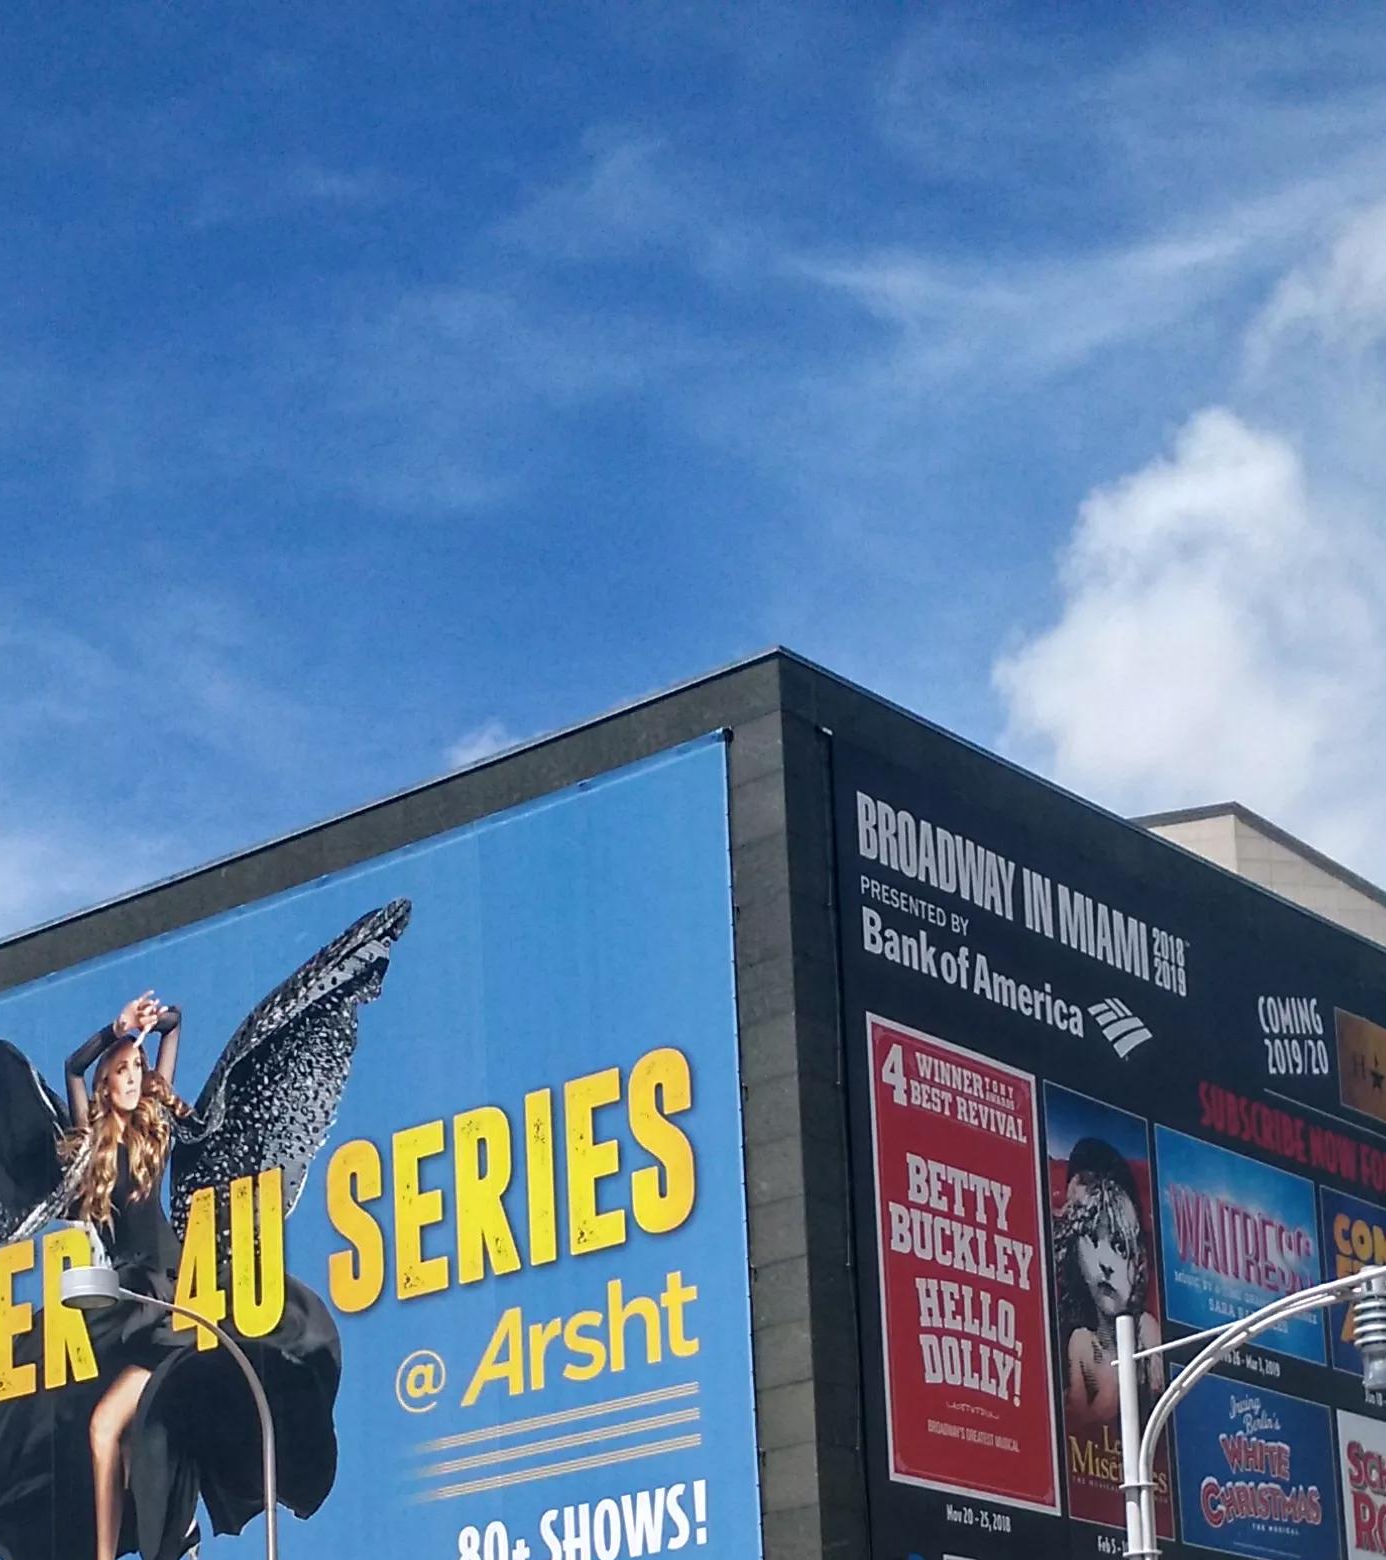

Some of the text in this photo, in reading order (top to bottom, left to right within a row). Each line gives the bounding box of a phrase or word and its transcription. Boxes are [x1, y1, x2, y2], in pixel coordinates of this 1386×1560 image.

[857, 790, 1150, 981] BROADWAY IN MIAMI
[860, 875, 969, 936] PRESENTED BY
[862, 906, 1084, 1038] Bank of America
[1152, 927, 1185, 967] 2018
[1154, 957, 1188, 997] 2019
[1258, 995, 1324, 1036] COMING
[881, 1044, 907, 1107] 4
[915, 1052, 985, 1099] WINNER
[1264, 1038, 1329, 1076] 2019/20
[910, 1079, 1027, 1144] BEST REVIVAL
[1199, 1080, 1307, 1164] SUBSCRIBE
[1308, 1119, 1357, 1184] NOW
[171, 1167, 285, 1352] 4U
[326, 1047, 695, 1312] SERIES
[906, 1152, 1011, 1231] BETTY
[888, 1201, 1033, 1291] BUCKLEY
[395, 1271, 700, 1413] @ Arsht
[915, 1277, 1023, 1358] HELLO,
[919, 1333, 1023, 1407] DOLLY!
[1229, 1394, 1261, 1420] Irving
[1219, 1431, 1291, 1482] WHITE
[946, 1504, 963, 1523] Nov
[963, 1506, 973, 1525] 20
[992, 1513, 1012, 1533] 2018
[1200, 1476, 1322, 1528] CHRISTMAS
[1098, 1535, 1111, 1554] Feb
[1111, 1538, 1116, 1554] 5
